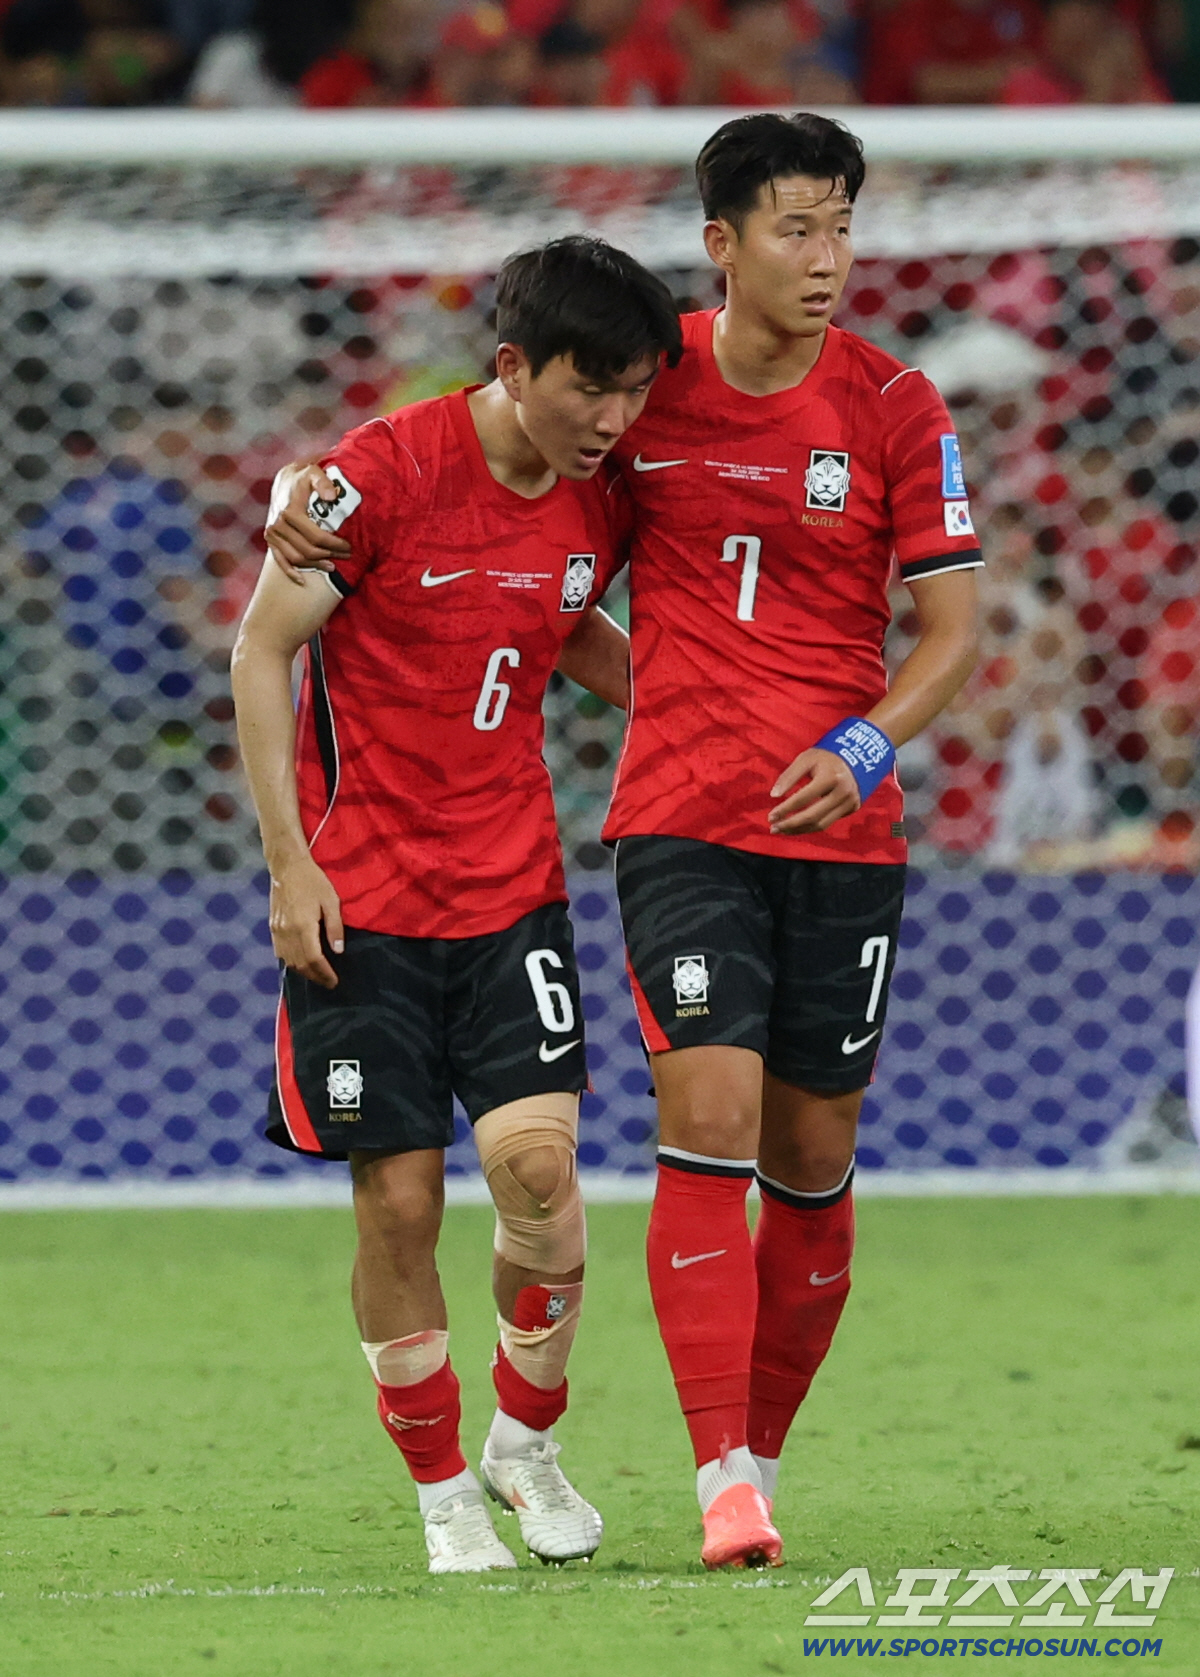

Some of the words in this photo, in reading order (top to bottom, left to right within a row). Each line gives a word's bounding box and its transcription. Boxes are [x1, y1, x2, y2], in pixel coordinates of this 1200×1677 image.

[801, 513, 844, 528] KOREA
[719, 534, 762, 622] 7
[473, 647, 521, 731] 6
[834, 735, 851, 747] the
[850, 743, 876, 772] World
[844, 726, 884, 763] UNITES
[853, 721, 890, 755] FOOTBALL
[525, 949, 574, 1033] 6
[858, 935, 889, 1023] 7
[675, 1005, 710, 1018] KOREA
[328, 1112, 362, 1122] KOREA
